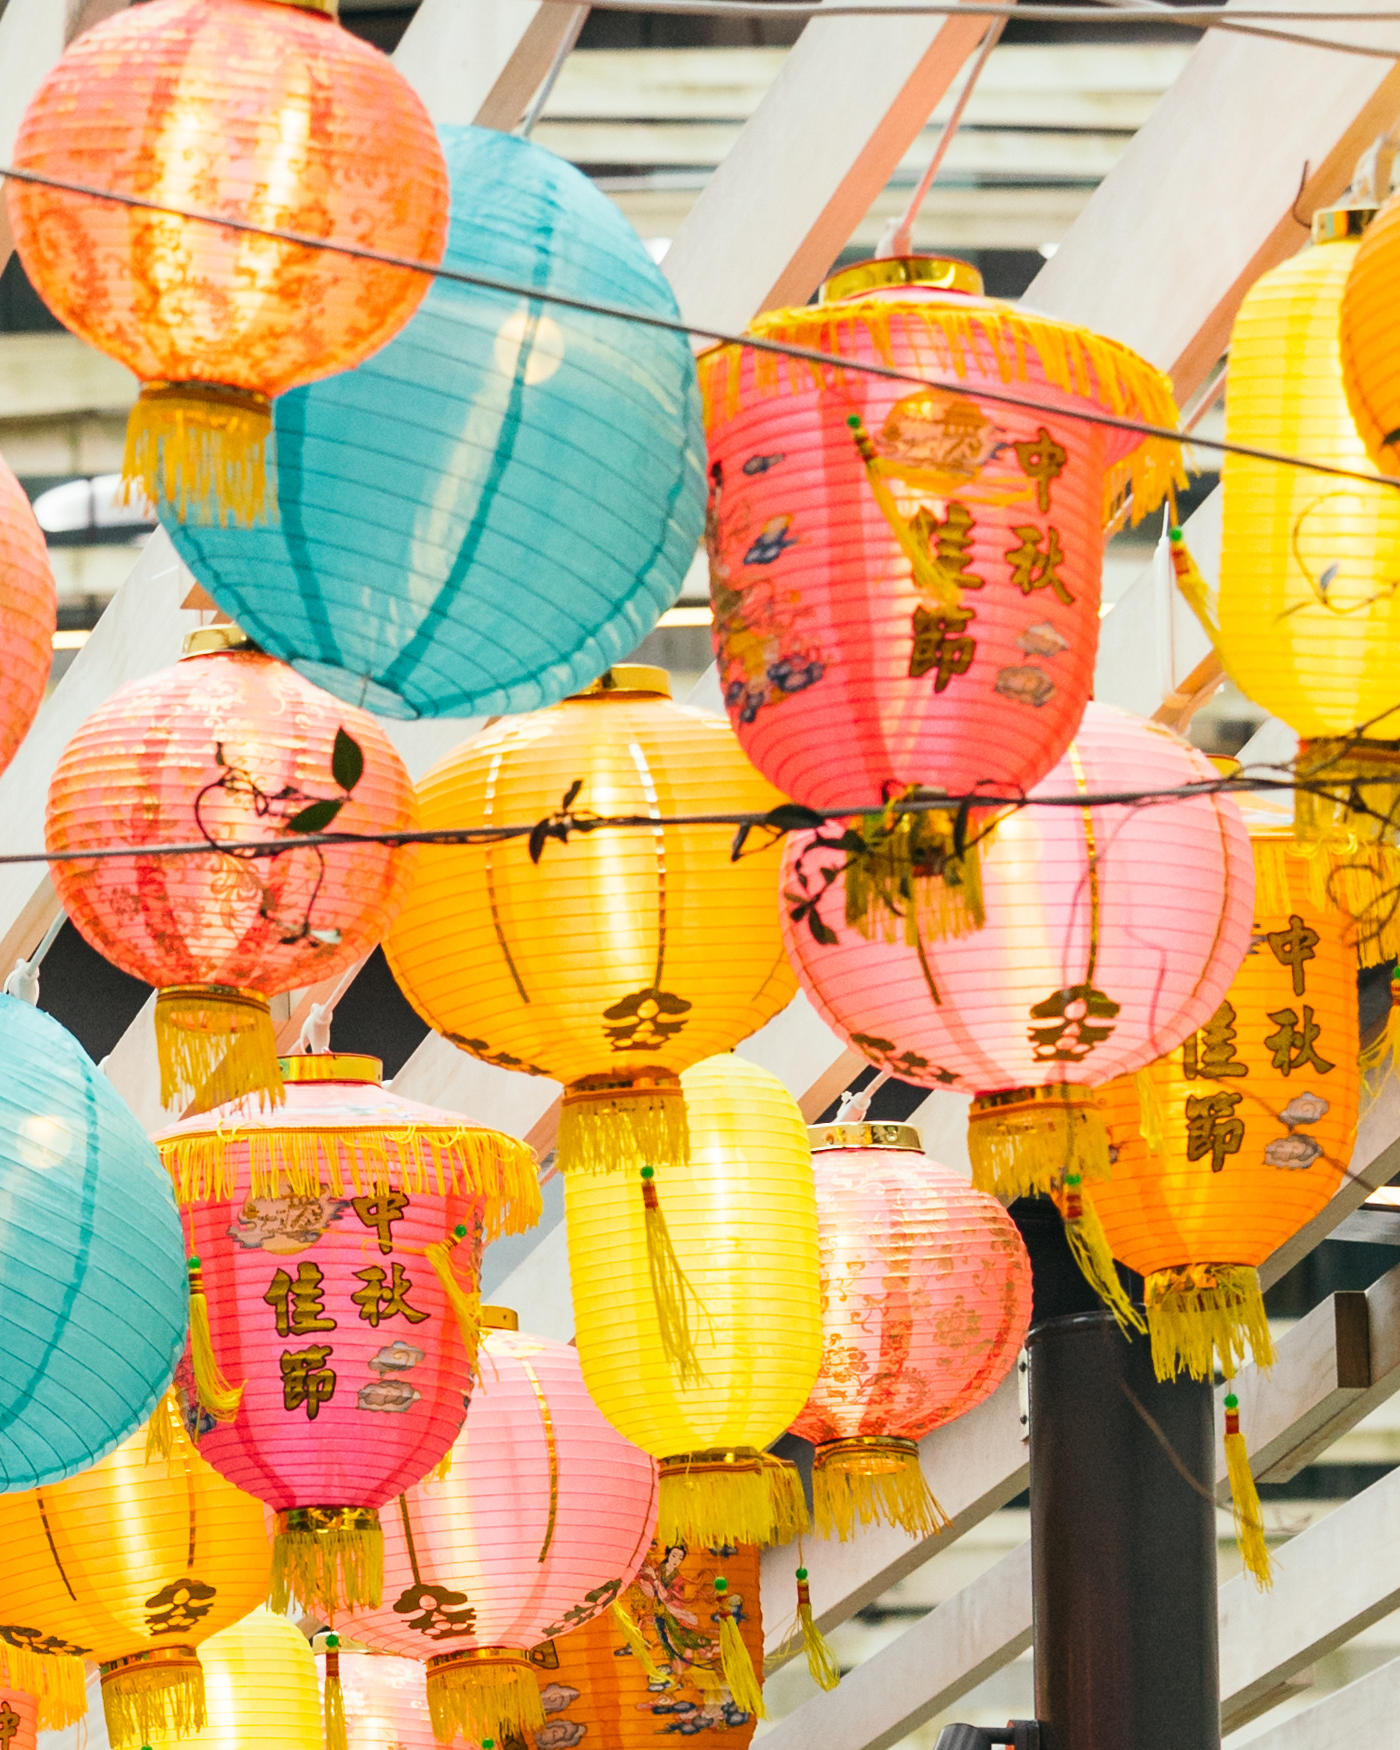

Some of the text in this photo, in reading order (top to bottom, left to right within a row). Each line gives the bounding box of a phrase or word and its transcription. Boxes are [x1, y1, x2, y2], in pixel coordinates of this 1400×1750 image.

[1005, 427, 1075, 606] 中秋
[1264, 914, 1336, 1077] 中秋
[351, 1181, 431, 1328] 中秋
